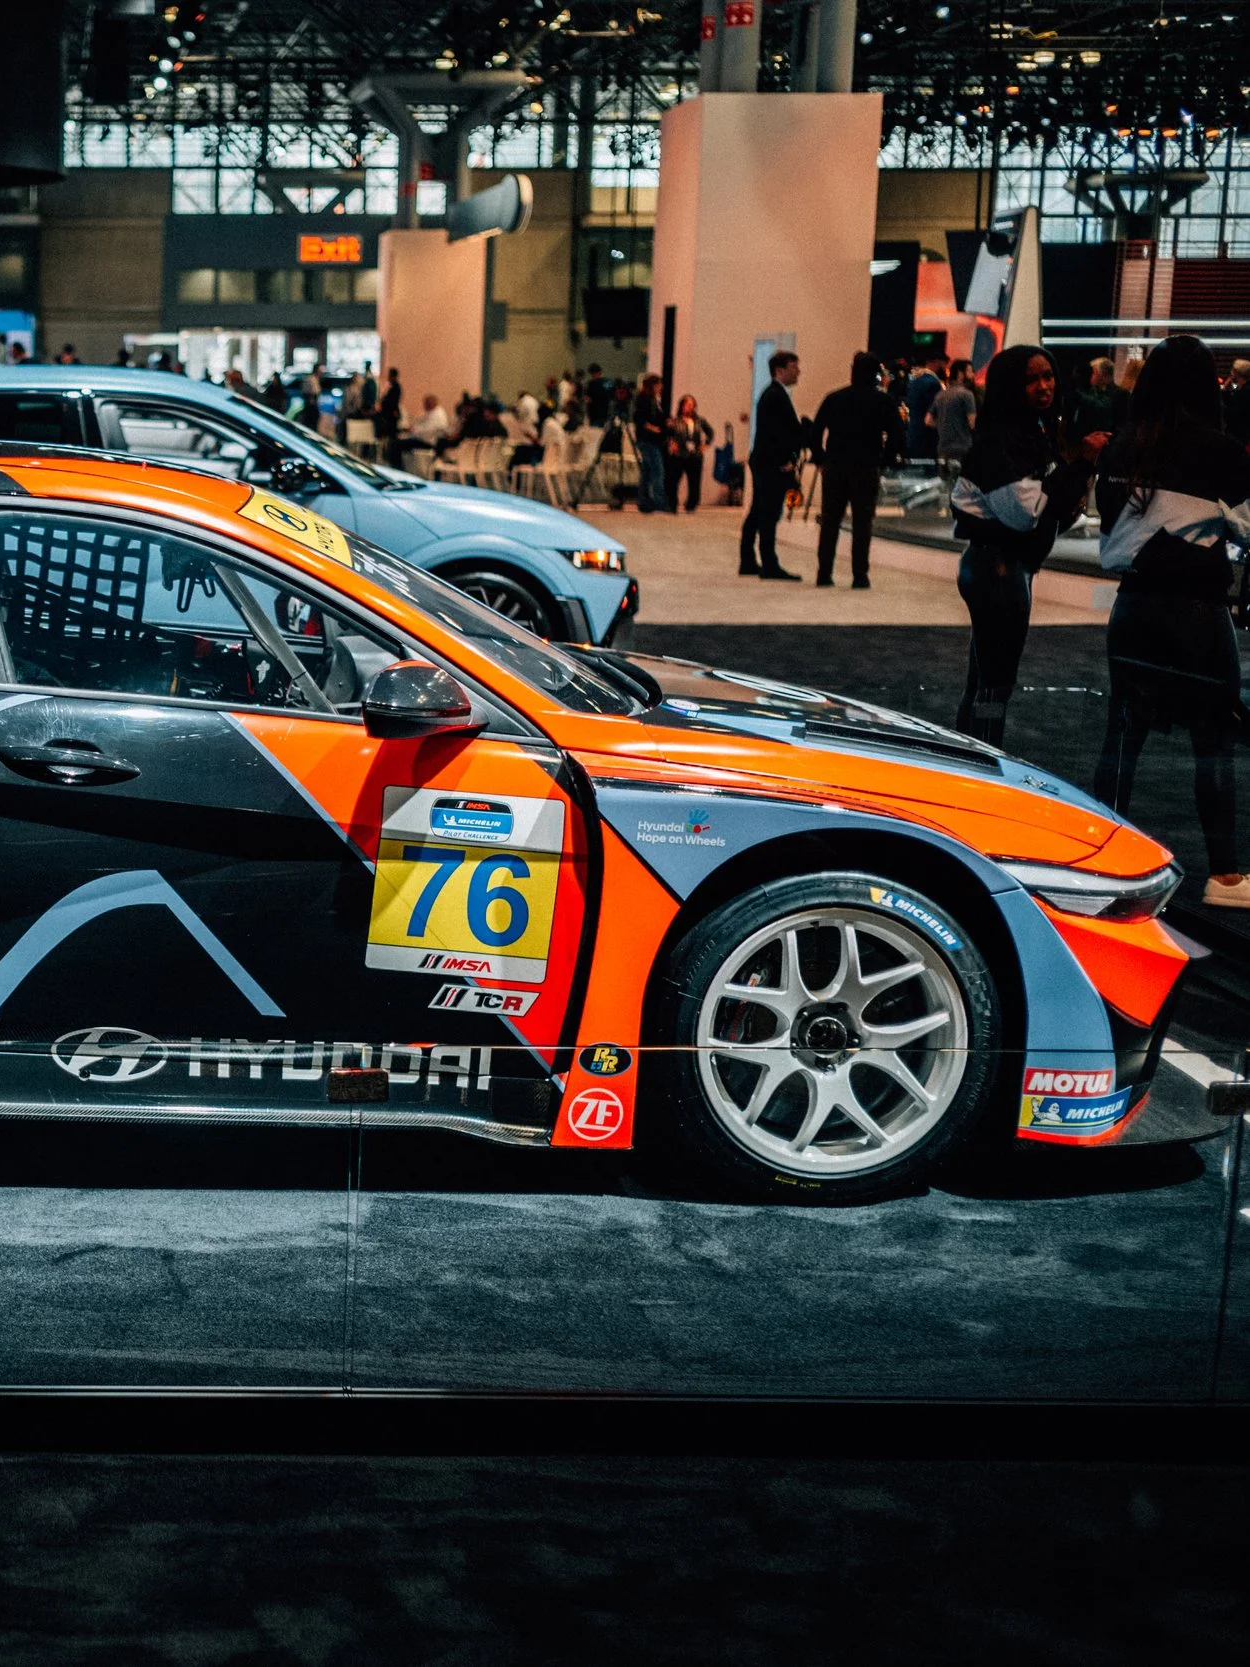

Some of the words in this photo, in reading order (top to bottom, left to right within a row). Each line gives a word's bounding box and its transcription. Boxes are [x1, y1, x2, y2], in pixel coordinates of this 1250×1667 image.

[299, 235, 361, 262] Exit
[466, 802, 491, 811] IMSA
[457, 818, 502, 828] MICHELIN
[637, 820, 686, 833] Hyundai
[636, 832, 667, 845] Hope
[668, 836, 683, 844] on
[685, 835, 726, 847] Wheels
[402, 845, 531, 947] 76
[894, 898, 957, 945] MICHELIN
[442, 958, 492, 973] IMSA
[473, 991, 524, 1011] TCR
[188, 1036, 492, 1090] HYUNDAI
[1027, 1071, 1109, 1094] MOTUL
[571, 1092, 622, 1137] ZF
[1065, 1098, 1125, 1120] MICHELIN
